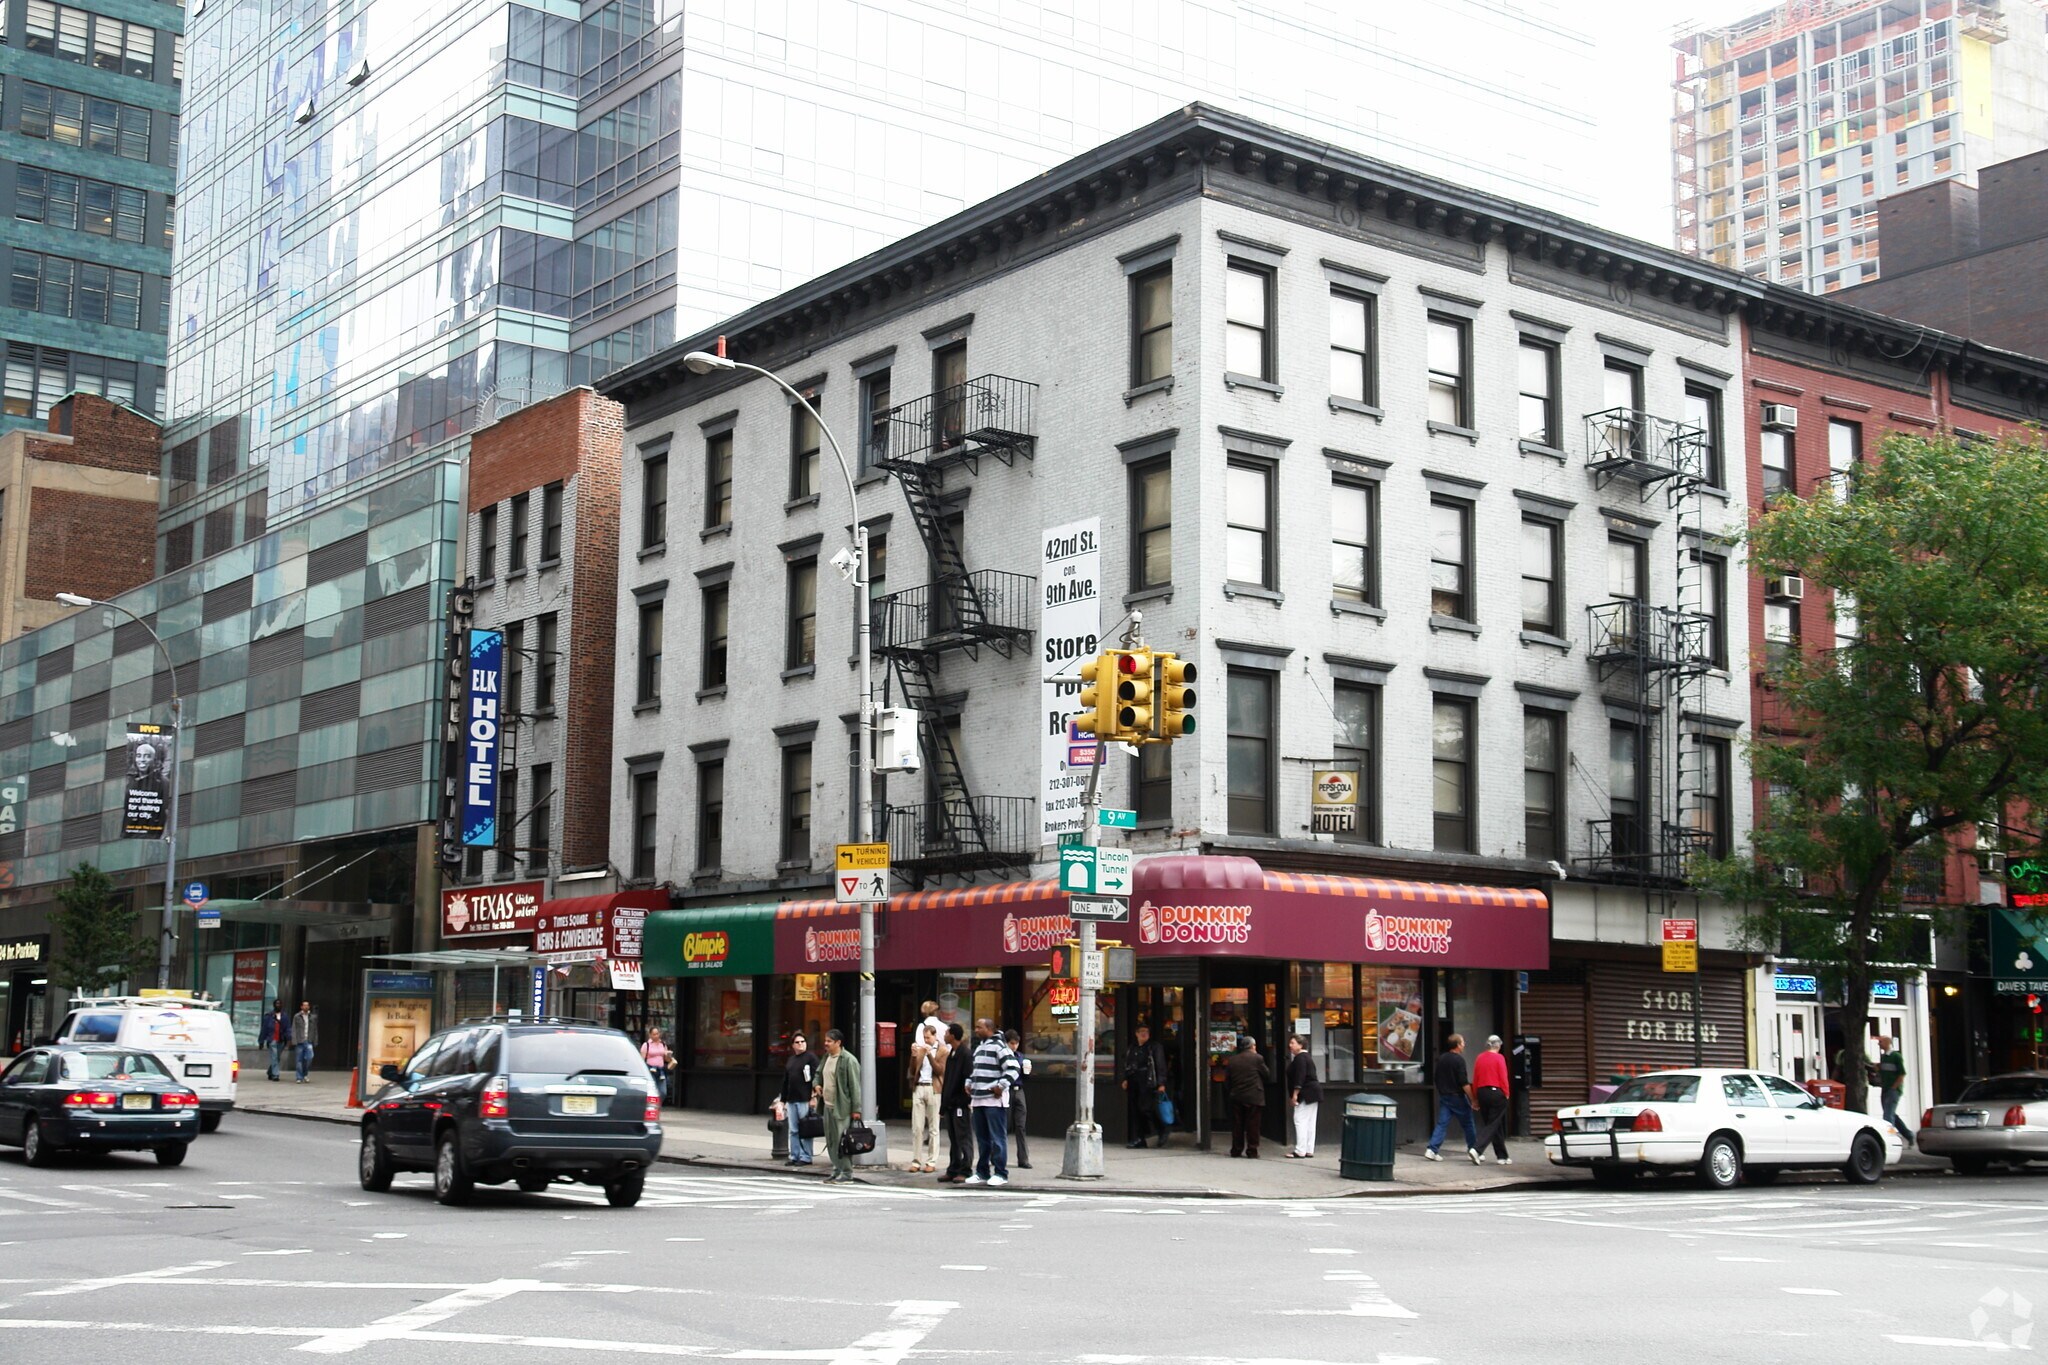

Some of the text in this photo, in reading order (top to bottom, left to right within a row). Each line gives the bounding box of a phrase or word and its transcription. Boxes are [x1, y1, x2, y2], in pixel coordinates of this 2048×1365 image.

[1046, 531, 1097, 560] 42nd St.
[1046, 579, 1096, 606] 9th Ave.
[1046, 634, 1096, 662] Store
[472, 669, 497, 692] ELK
[140, 725, 160, 733] NYC
[469, 698, 496, 806] HOTEL
[1050, 776, 1086, 790] 212-307-08
[138, 804, 160, 813] visiting
[1108, 811, 1116, 824] 9
[1314, 814, 1355, 831] HOTEL
[856, 847, 887, 855] TURNING
[1100, 851, 1129, 862] Lincoln
[1102, 864, 1128, 874] Tunnel
[472, 892, 514, 922] TEXAS
[515, 906, 525, 917] and
[1074, 903, 1119, 914] ONE WAY
[1161, 906, 1252, 924] DUNKIN'
[569, 914, 588, 927] SQUARE
[1385, 916, 1452, 936] DUNKIN'
[537, 927, 604, 951] NEWS & CONVENIENCE
[1161, 924, 1248, 943] DONUTS
[16, 942, 40, 960] Parking
[684, 932, 726, 962] Blimpie
[1385, 934, 1449, 954] DONUTS
[818, 944, 861, 962] DONUTS
[614, 960, 639, 973] ATM
[704, 960, 723, 968] SALADS
[536, 970, 542, 979] 42
[1998, 982, 2026, 991] DAVE'S
[399, 1001, 428, 1010] Bagging
[1642, 987, 1703, 1011] STOR
[1628, 1020, 1667, 1040] FOR
